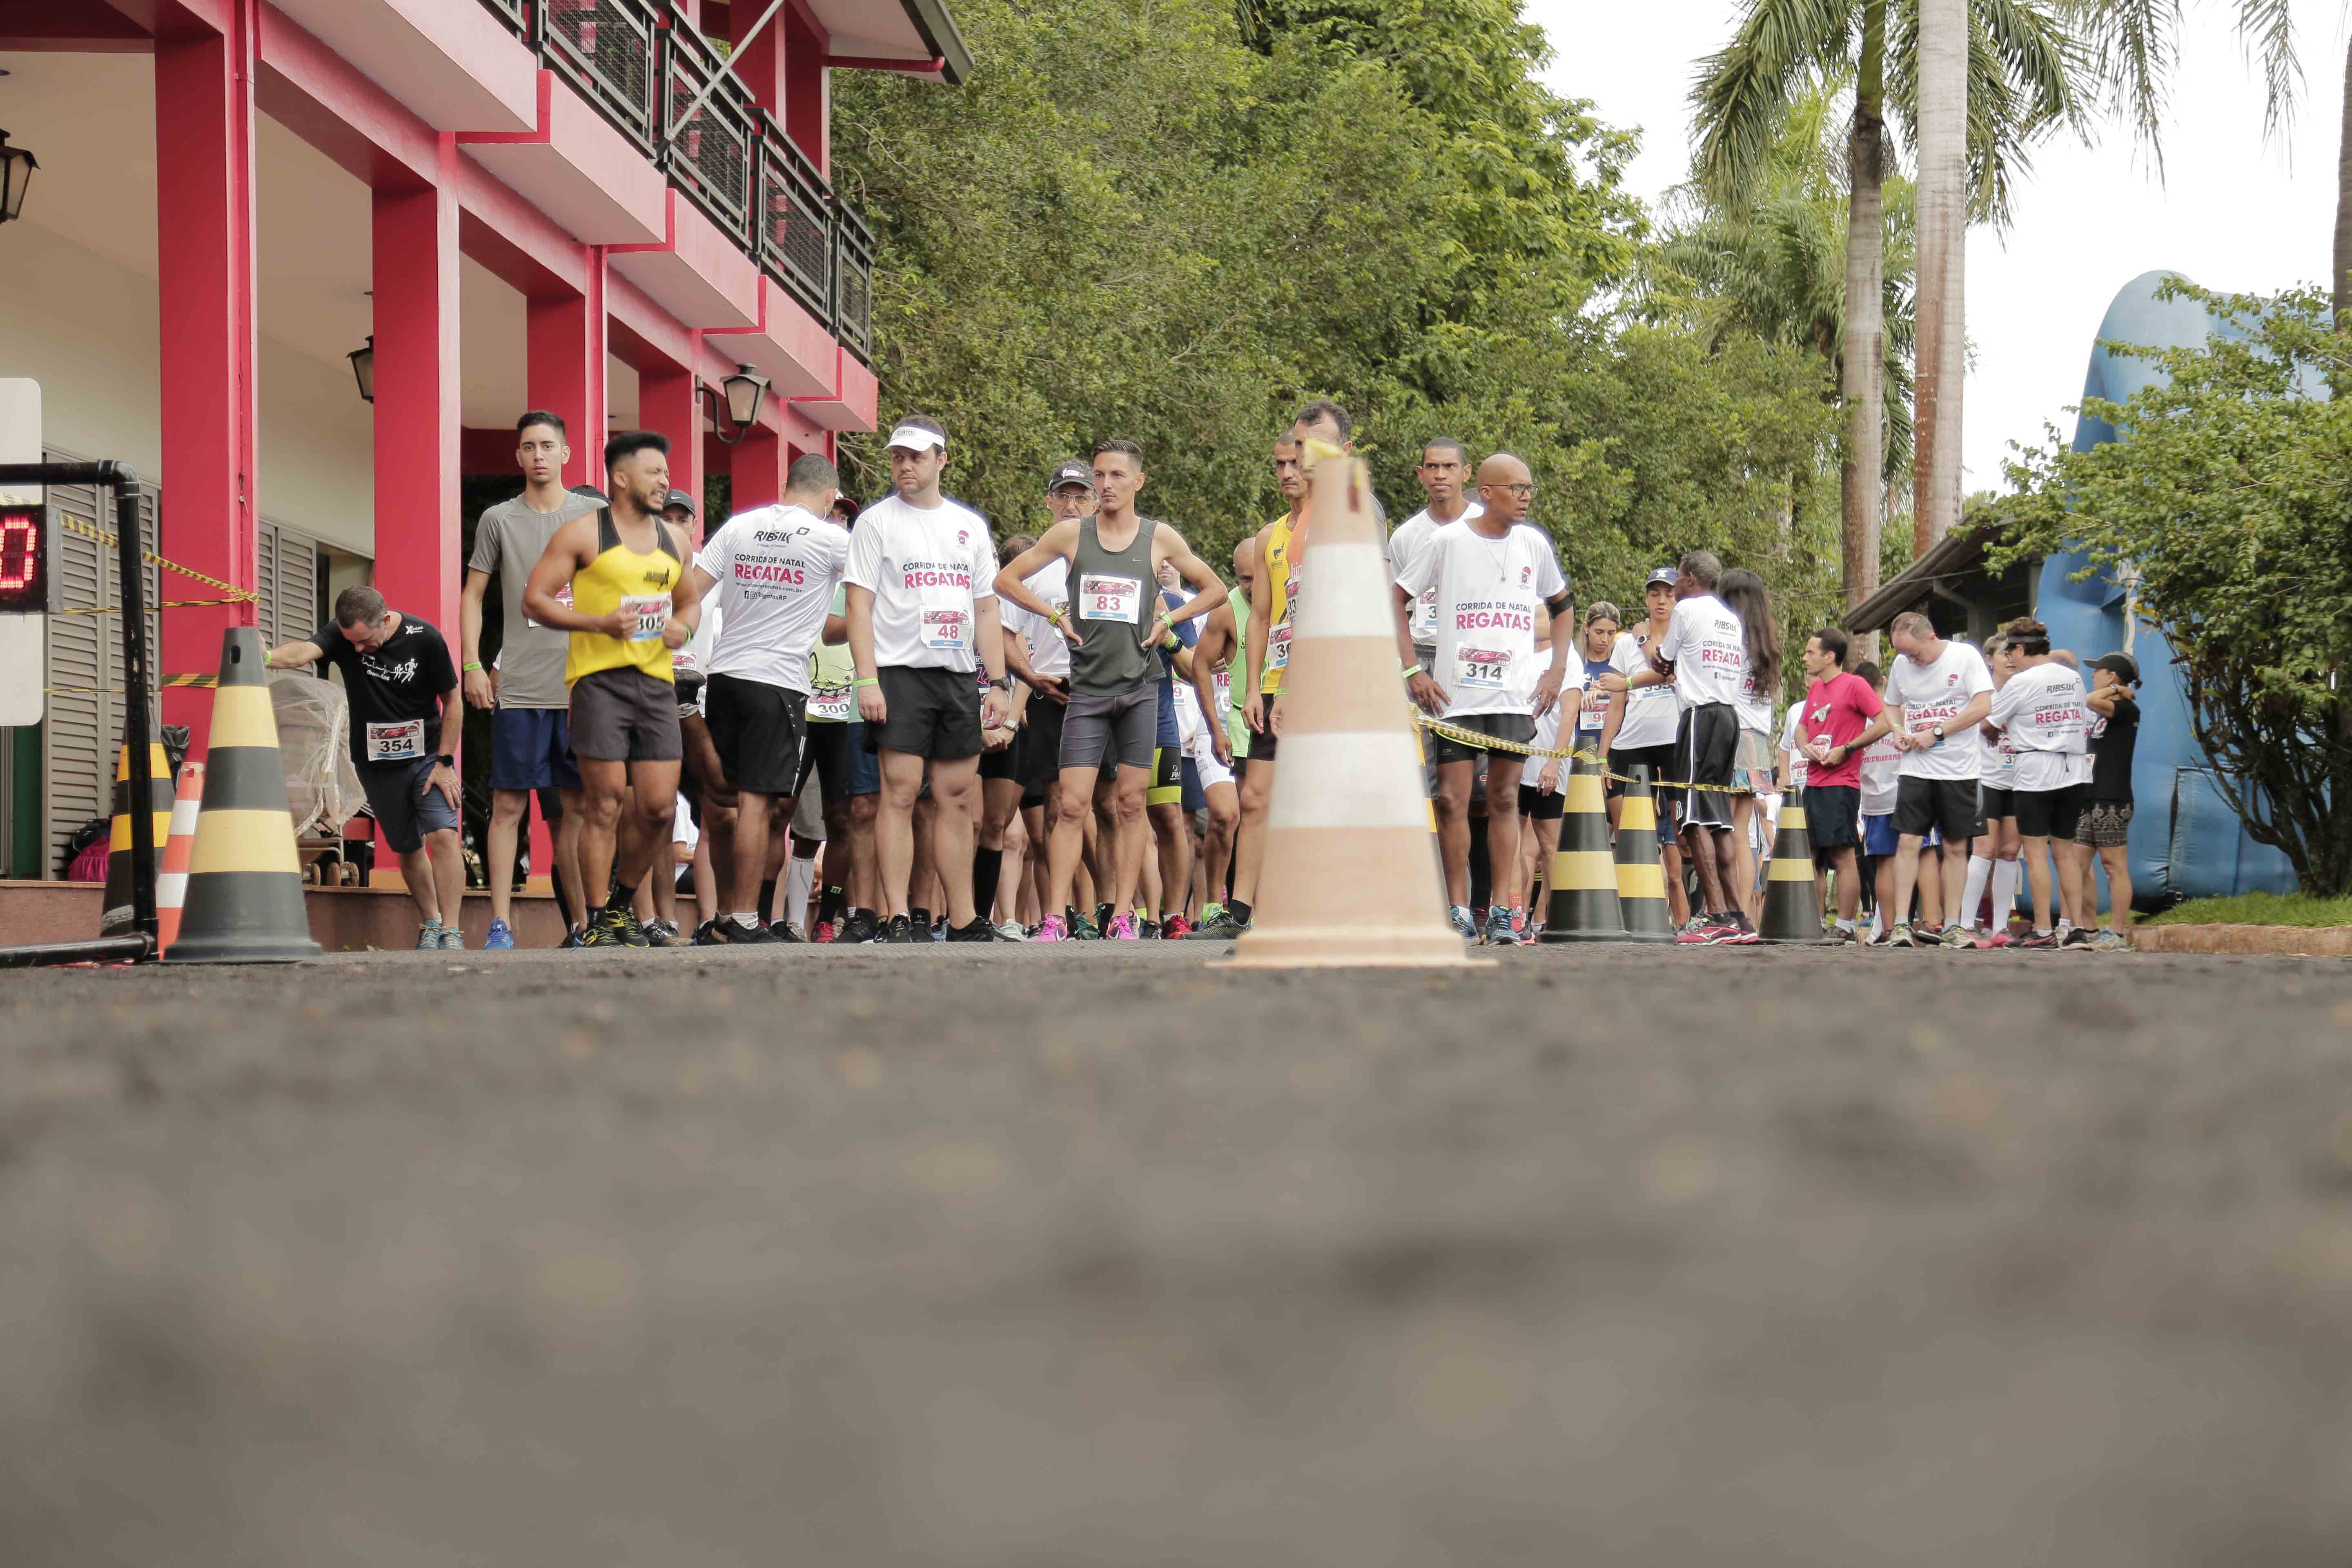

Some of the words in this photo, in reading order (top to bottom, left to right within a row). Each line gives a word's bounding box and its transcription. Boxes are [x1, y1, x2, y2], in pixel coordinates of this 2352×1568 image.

[0, 514, 36, 589] 0
[735, 554, 767, 563] CORRIDA
[779, 558, 805, 568] NATAL
[903, 562, 935, 571] CORRIDA
[950, 564, 969, 572] NATA
[735, 564, 804, 585] REGATAS
[905, 572, 970, 590] REGATAS
[1097, 596, 1120, 610] 83
[1288, 599, 1296, 615] 33
[1456, 602, 1492, 611] CORRIDA
[1509, 603, 1531, 612] NATAL
[1428, 606, 1437, 619] 3
[1456, 612, 1531, 631] REGATAS
[938, 625, 958, 639] 48
[1702, 649, 1740, 667] REGATA
[1466, 663, 1502, 680] 314
[1216, 674, 1229, 686] RE
[1174, 687, 1182, 697] 9
[1907, 707, 1957, 721] EGATAS
[2036, 709, 2082, 724] REGATA
[380, 739, 413, 752] 354
